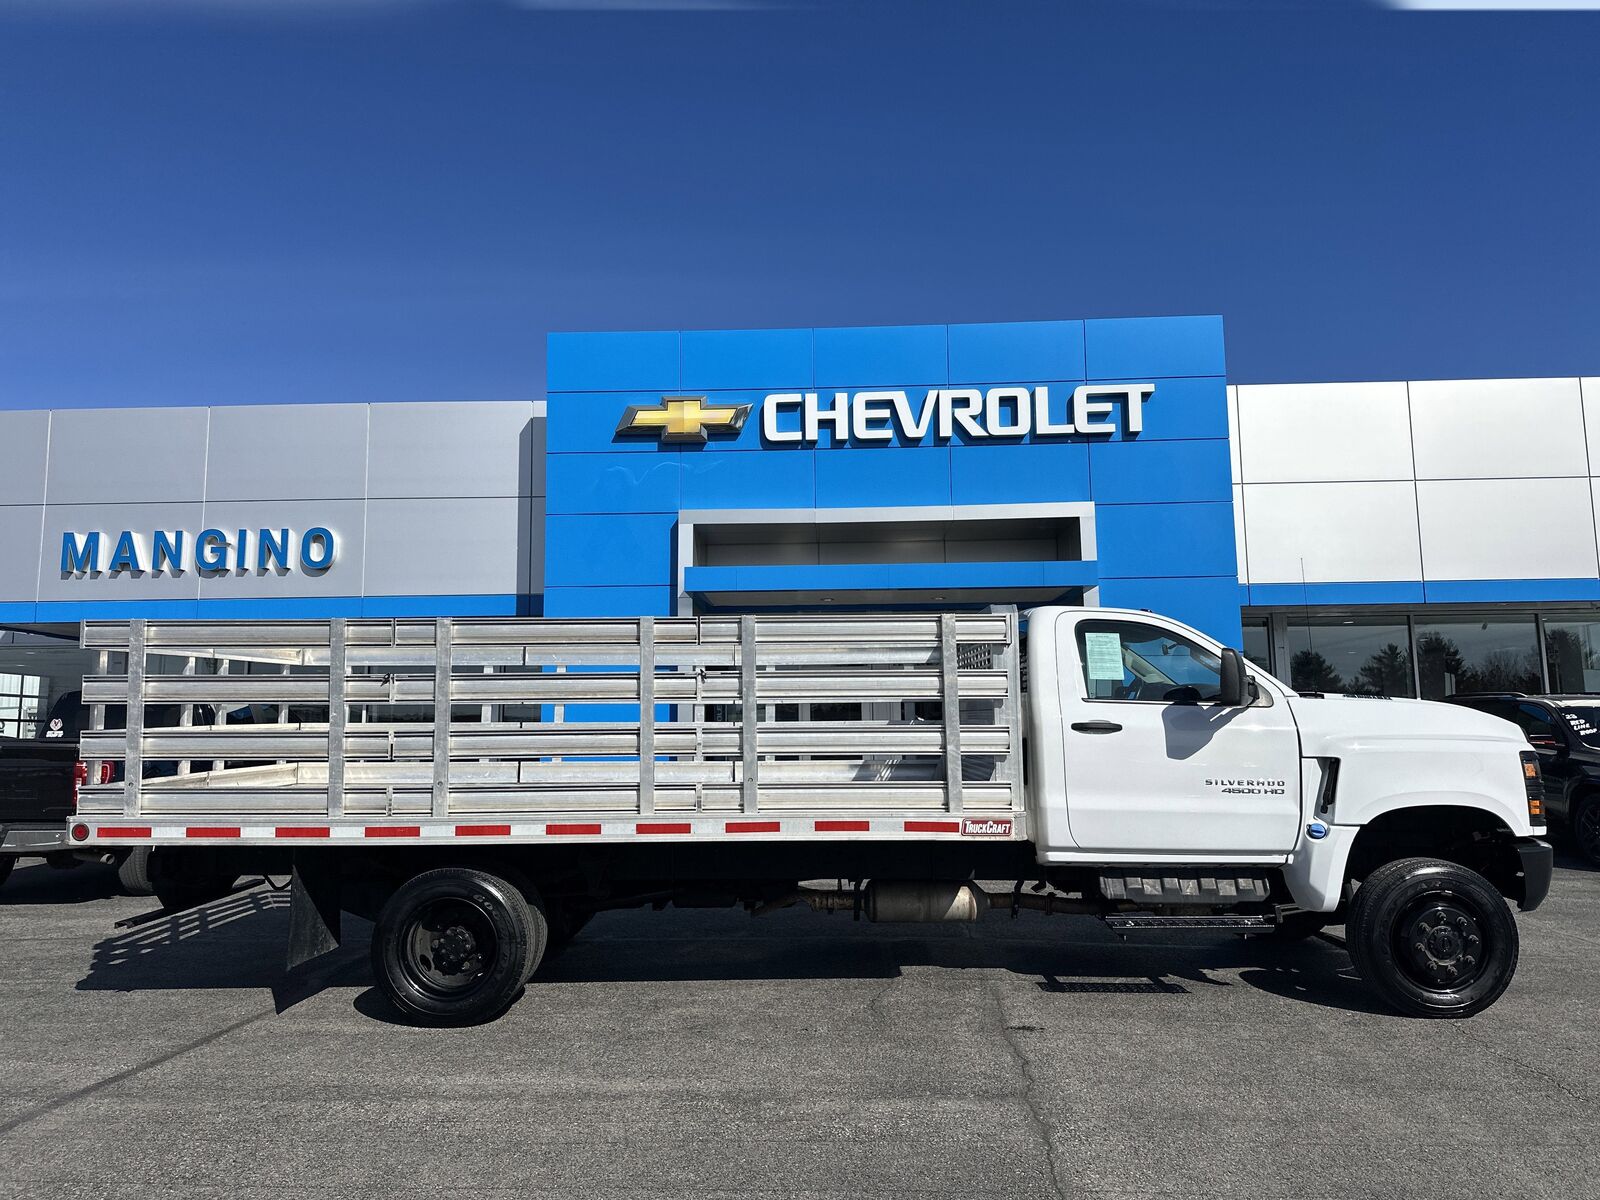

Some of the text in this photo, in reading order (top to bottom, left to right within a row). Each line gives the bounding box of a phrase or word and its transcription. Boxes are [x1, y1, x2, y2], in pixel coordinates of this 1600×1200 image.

[763, 383, 1156, 442] CHEVROLET
[61, 527, 335, 572] MANGINO
[1205, 779, 1286, 787] SILVERADO
[1221, 787, 1261, 795] 4500
[965, 820, 1011, 834] TRUCKCRAFT
